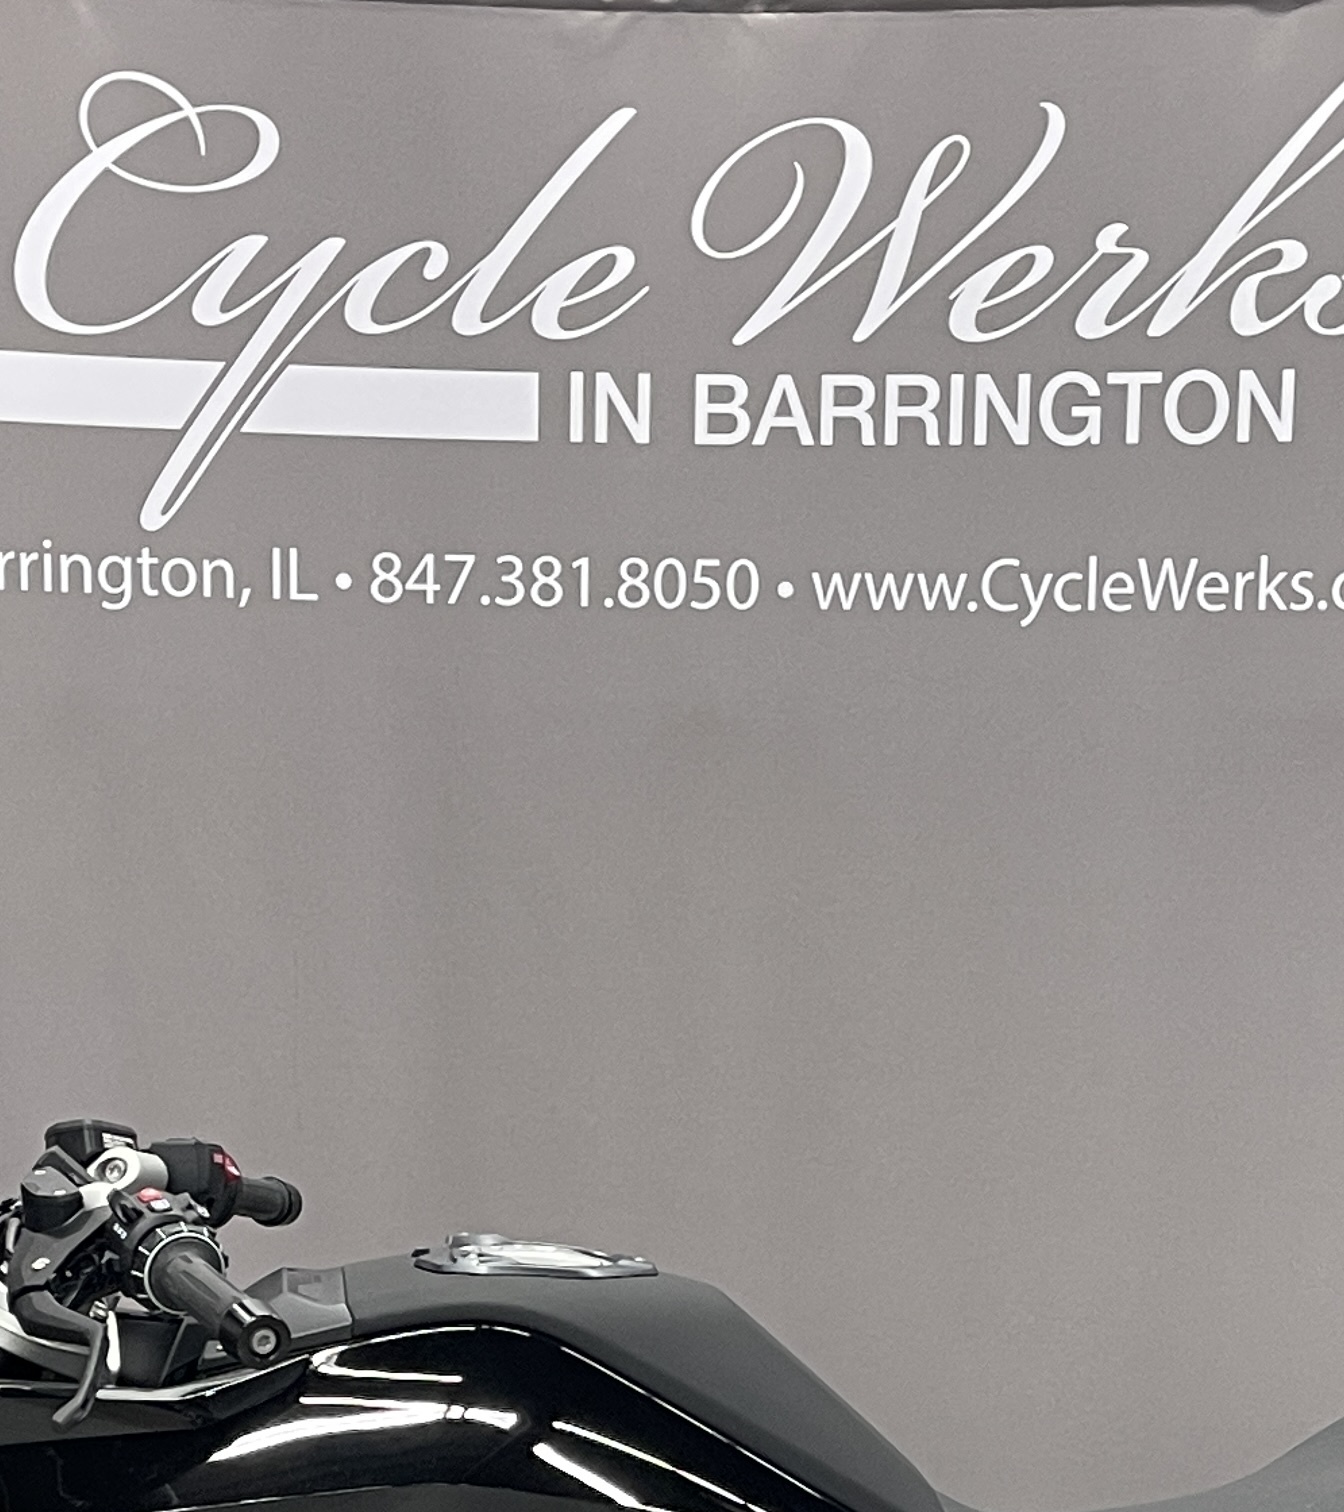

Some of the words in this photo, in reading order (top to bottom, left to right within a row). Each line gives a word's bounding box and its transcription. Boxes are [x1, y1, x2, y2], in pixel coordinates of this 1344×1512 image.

[14, 70, 651, 532] Cycle
[569, 371, 651, 444] IN
[694, 368, 1295, 446] BARRINGTON
[272, 547, 319, 601] IL
[370, 551, 759, 610] 847.381.8050
